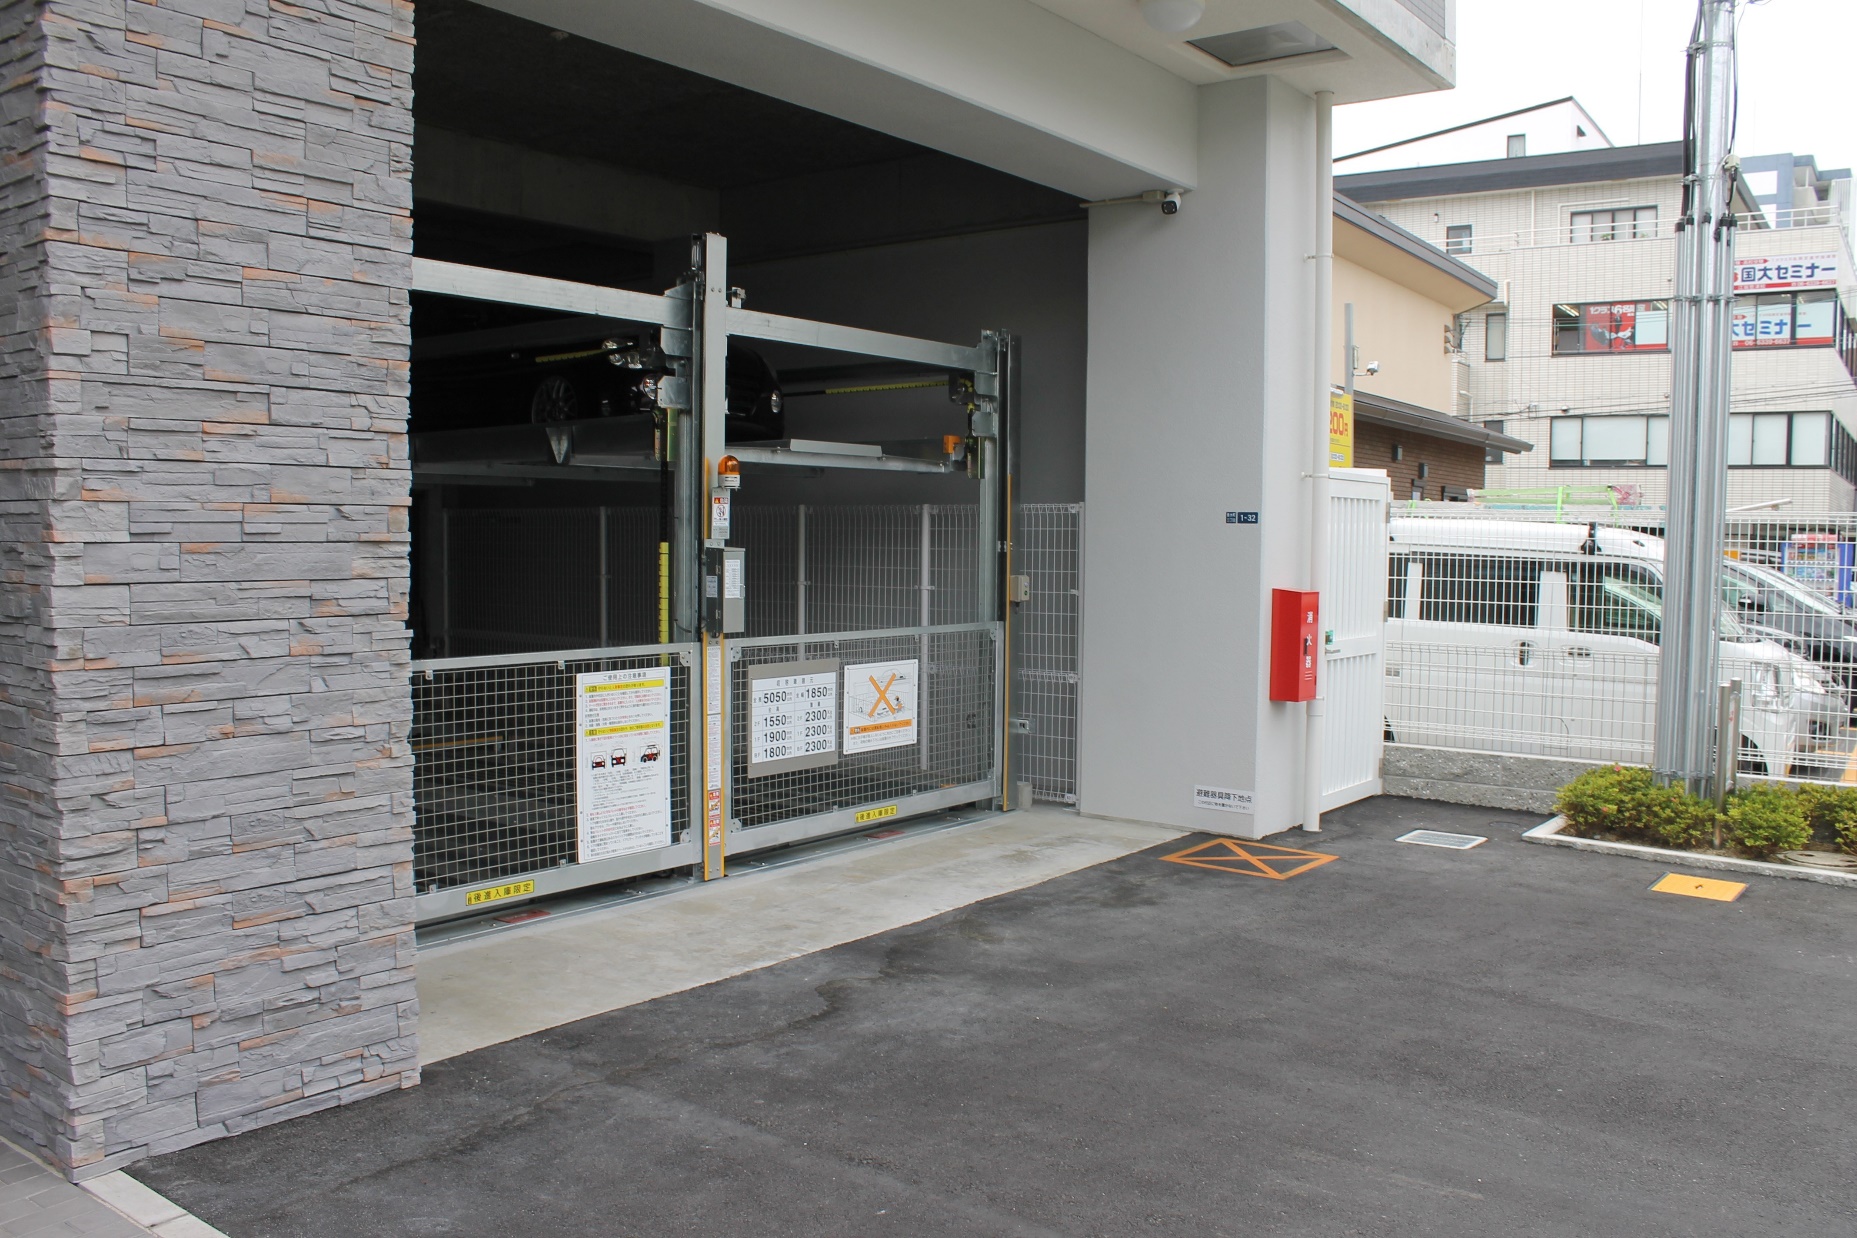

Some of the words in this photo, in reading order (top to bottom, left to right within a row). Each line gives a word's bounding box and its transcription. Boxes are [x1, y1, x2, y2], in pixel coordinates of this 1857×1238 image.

[1741, 263, 1836, 282] 国大セミナー
[1240, 514, 1256, 522] 1-32
[1305, 611, 1313, 668] 消火器
[763, 691, 787, 704] 5050
[805, 686, 828, 699] 1850
[763, 714, 787, 727] 1550
[805, 709, 828, 722] 2300
[763, 730, 787, 743] 1900
[805, 724, 828, 737] 2300
[763, 745, 787, 758] 1800
[805, 739, 828, 752] 2300
[473, 883, 531, 902] 後進入庫限定
